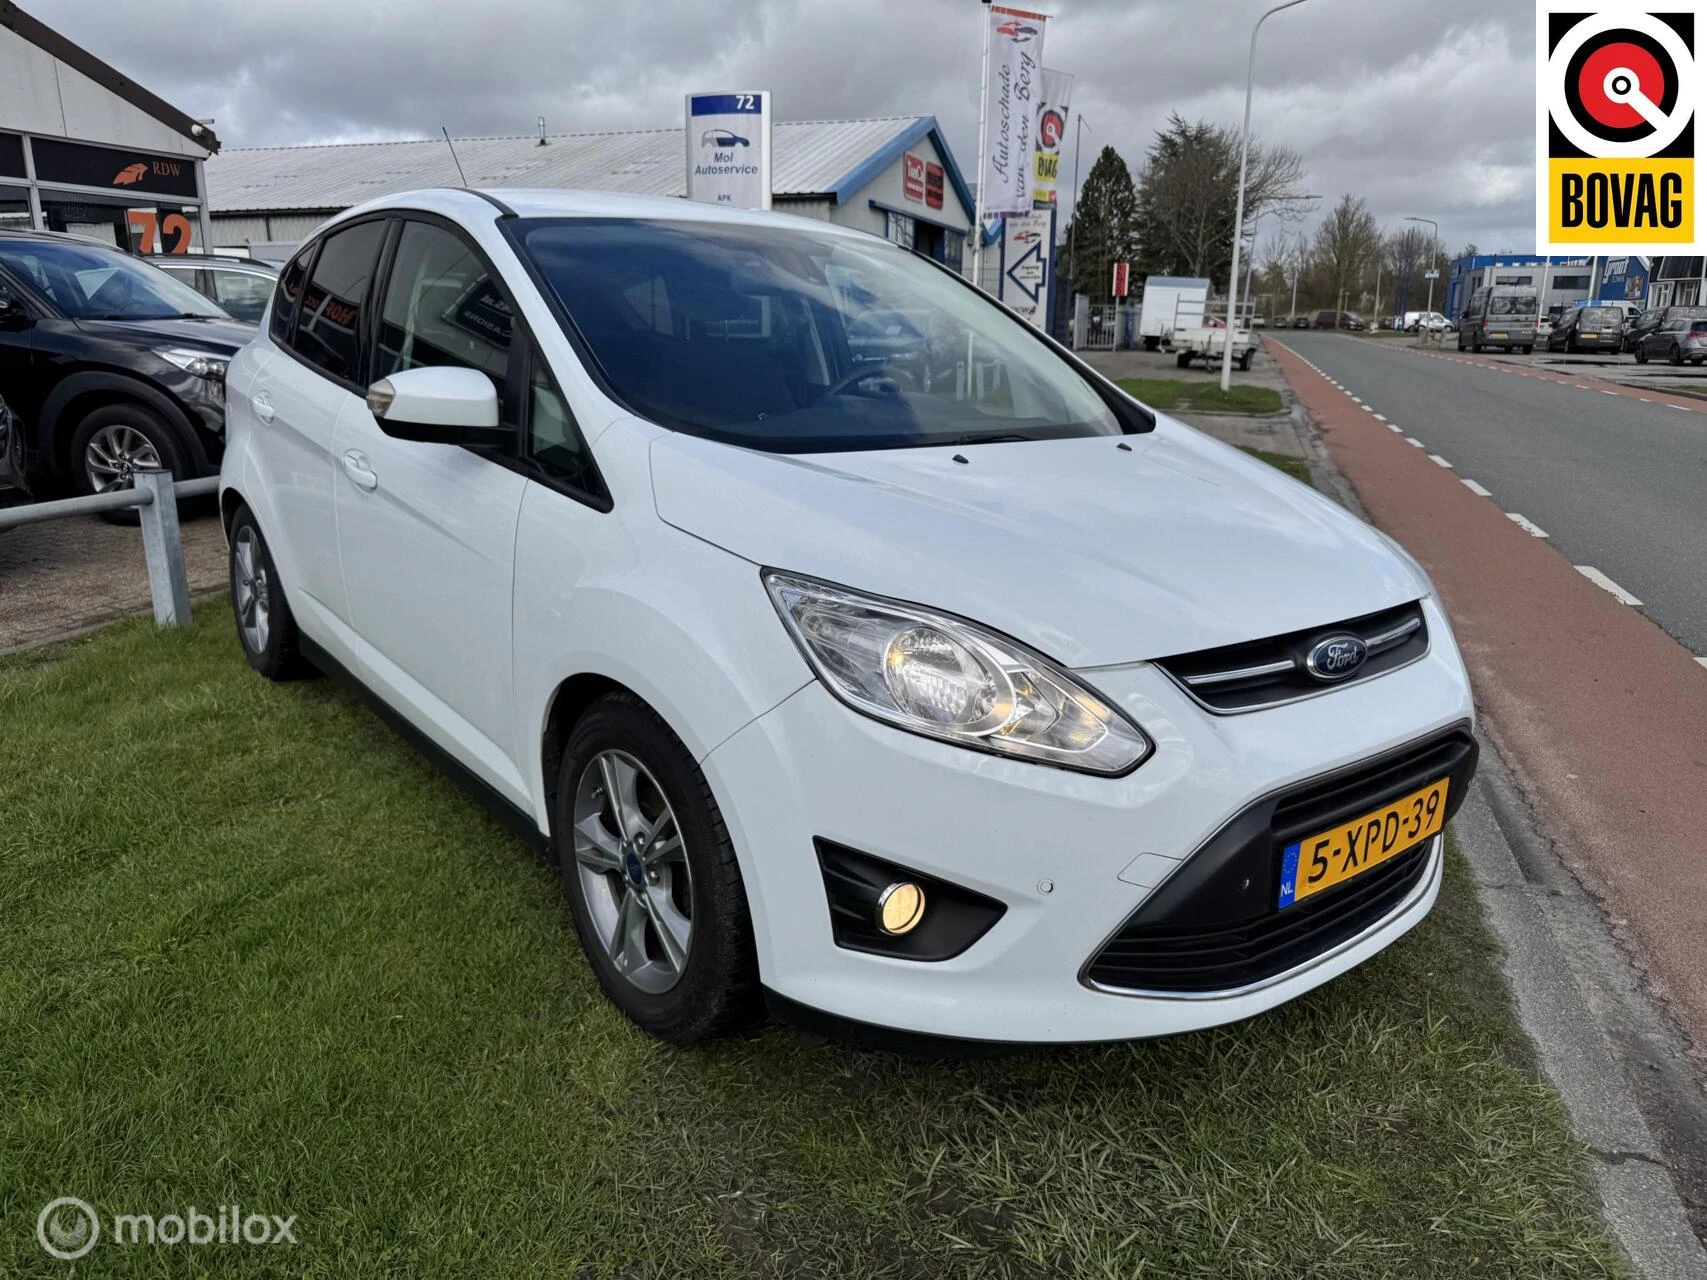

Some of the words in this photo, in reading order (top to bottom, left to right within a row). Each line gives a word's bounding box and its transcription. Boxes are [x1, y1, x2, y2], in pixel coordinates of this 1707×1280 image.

[1013, 51, 1037, 103] Berg
[736, 95, 755, 110] 72
[992, 64, 1011, 184] Autoschade
[1016, 113, 1030, 153] den
[152, 160, 181, 177] RDW
[694, 164, 759, 176] Autoservice
[714, 152, 734, 163] Mol
[1016, 162, 1026, 198] van
[717, 194, 732, 203] APK
[127, 211, 192, 255] 72
[1326, 642, 1359, 671] Ford
[1280, 880, 1294, 897] NL
[1307, 789, 1440, 884] 5-XPD-39
